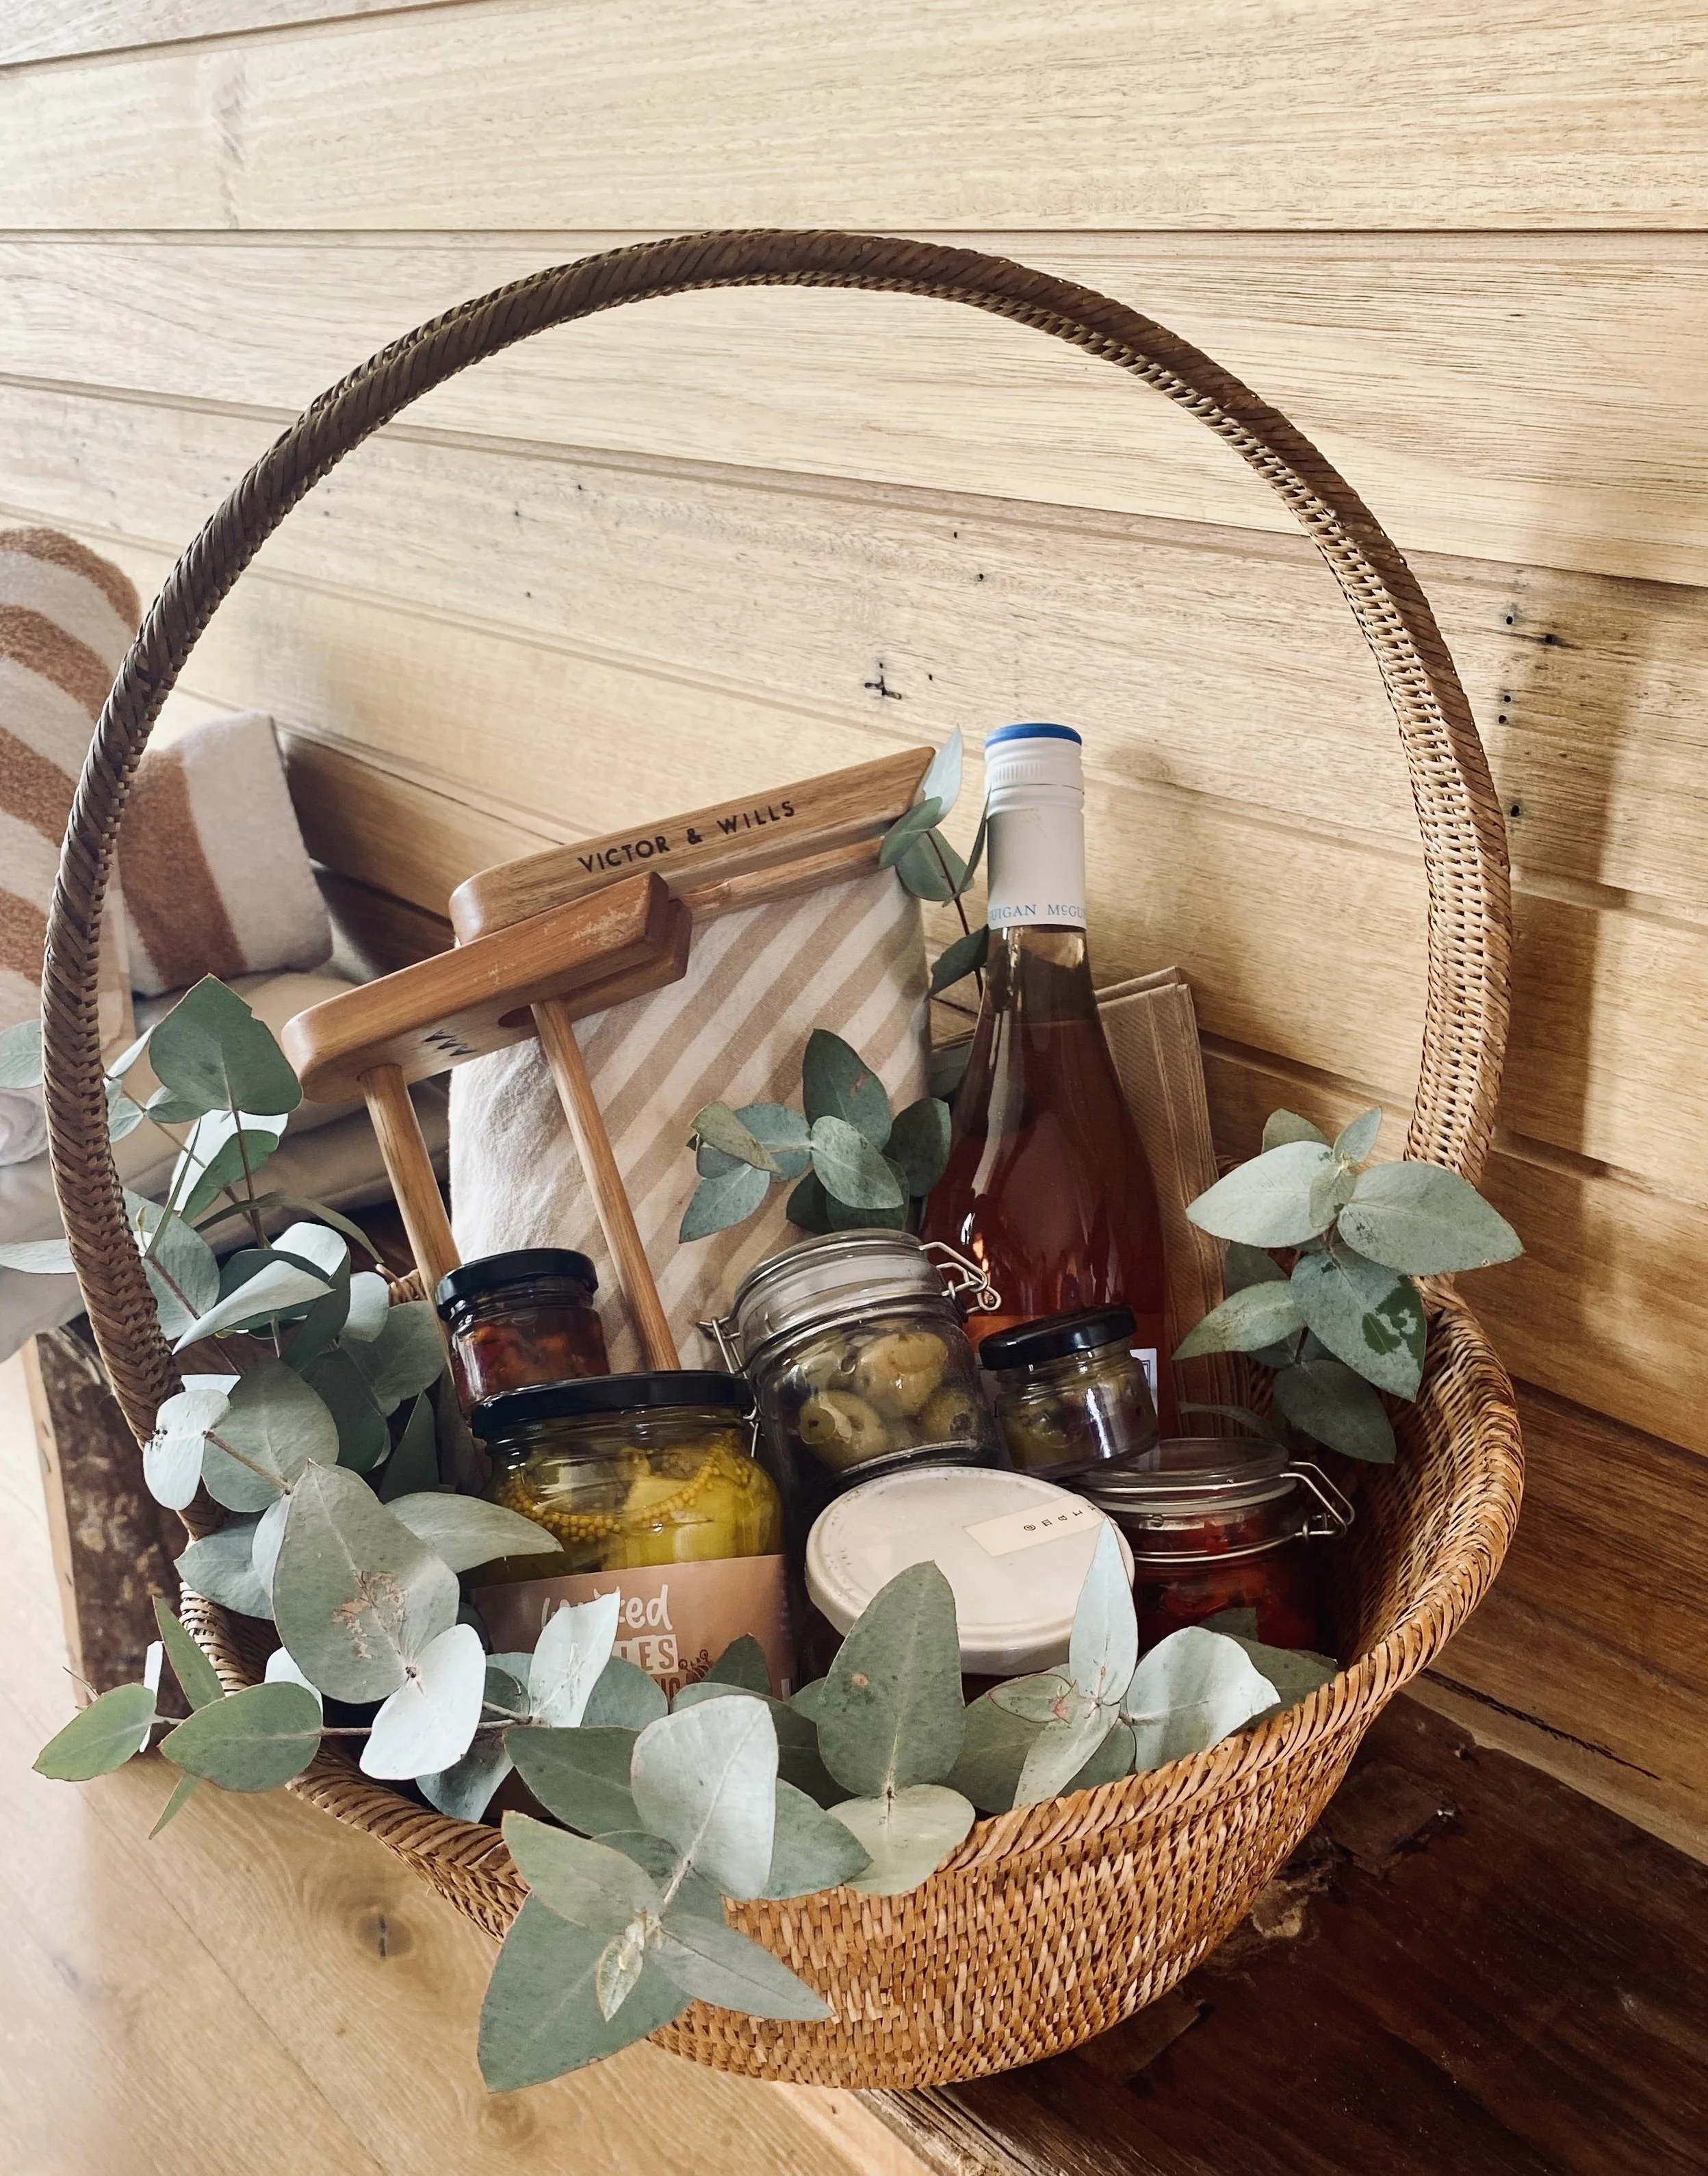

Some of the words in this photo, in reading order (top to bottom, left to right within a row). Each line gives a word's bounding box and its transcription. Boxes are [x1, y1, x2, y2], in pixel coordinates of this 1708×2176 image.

[578, 836, 671, 873] VICTOR
[686, 828, 703, 845] &
[716, 800, 794, 835] WILLS
